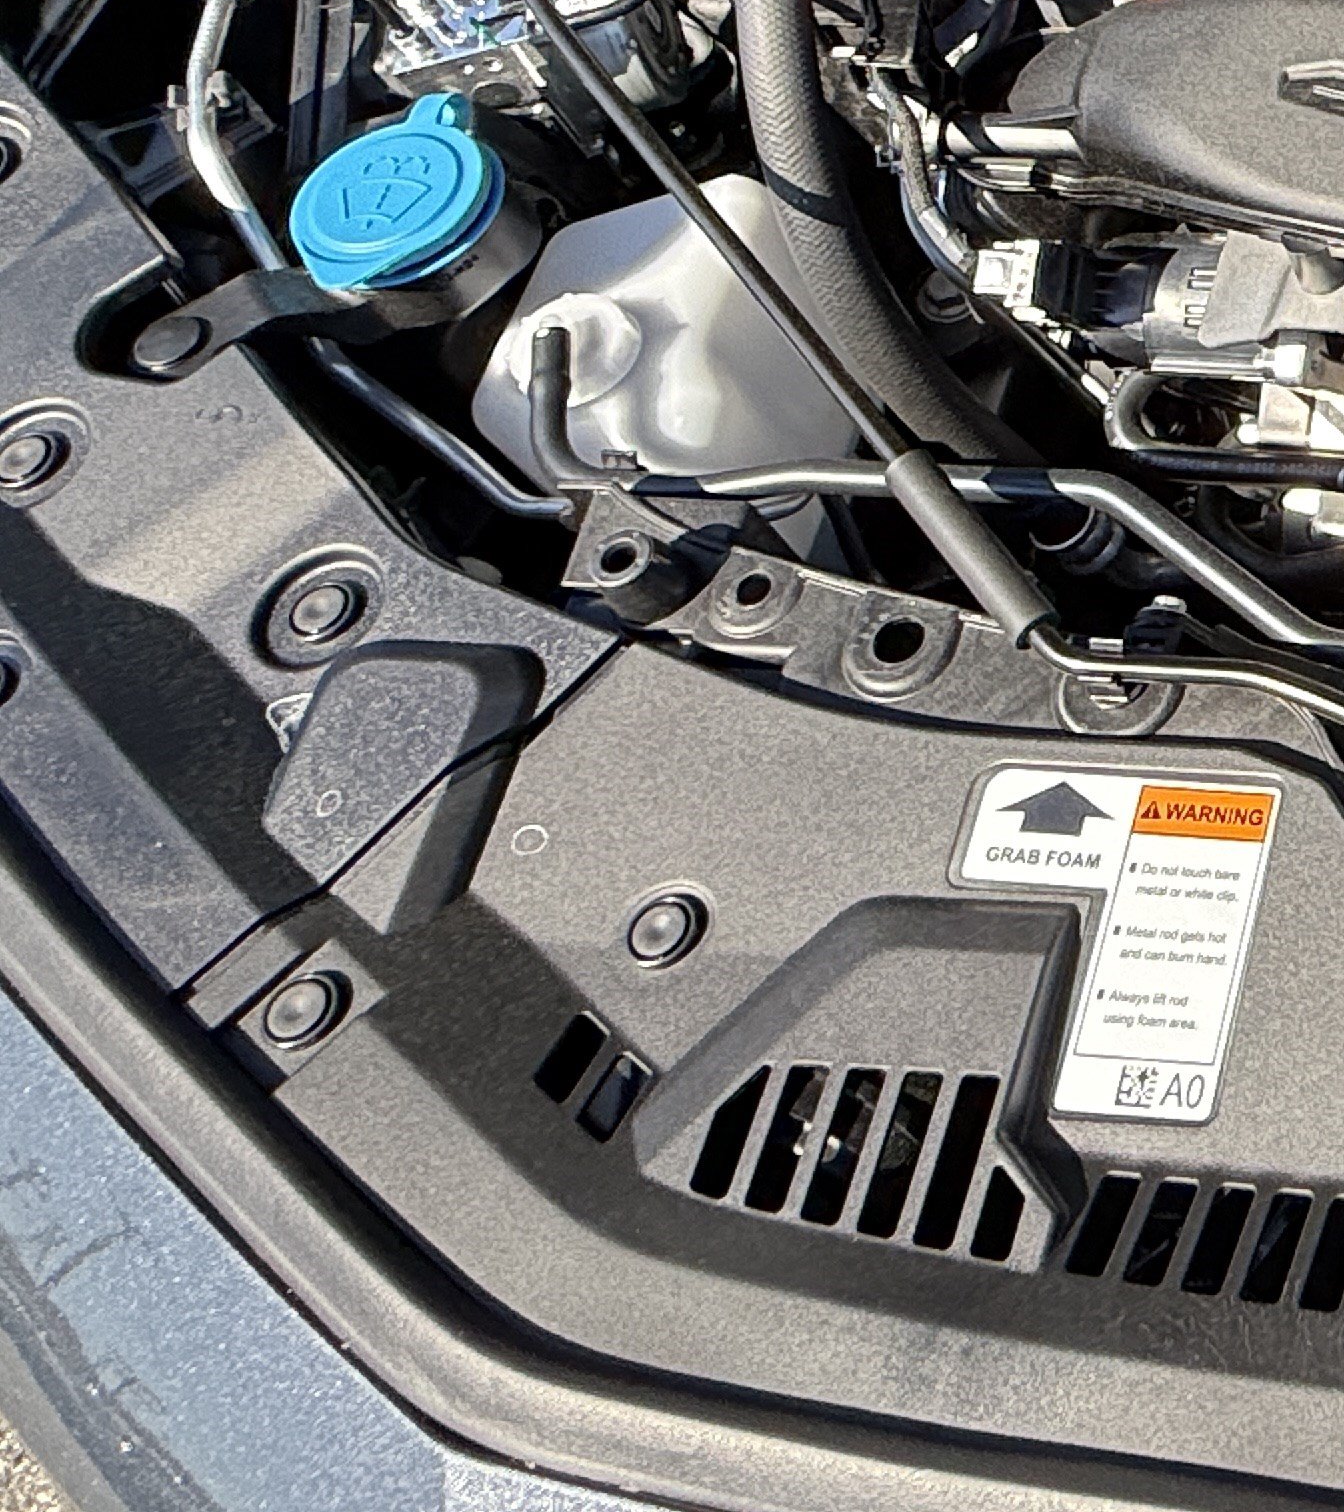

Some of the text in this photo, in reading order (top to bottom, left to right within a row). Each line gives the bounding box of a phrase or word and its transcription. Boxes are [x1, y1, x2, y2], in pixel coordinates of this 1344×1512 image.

[1165, 802, 1264, 826] WARNING
[985, 846, 1102, 870] GRAB FOAM
[1141, 862, 1241, 881] Do not touch bare
[1135, 885, 1168, 896] metal
[1169, 888, 1182, 897] or
[1184, 887, 1214, 900] white
[1126, 925, 1228, 944] Metal rod gets hot
[1119, 948, 1143, 960] and
[1144, 950, 1166, 961] can
[1167, 950, 1194, 964] burn
[1108, 989, 1190, 1007] Always lift rod
[1103, 1013, 1136, 1028] using
[1136, 1013, 1167, 1028] foam
[1159, 1072, 1206, 1109] A0
